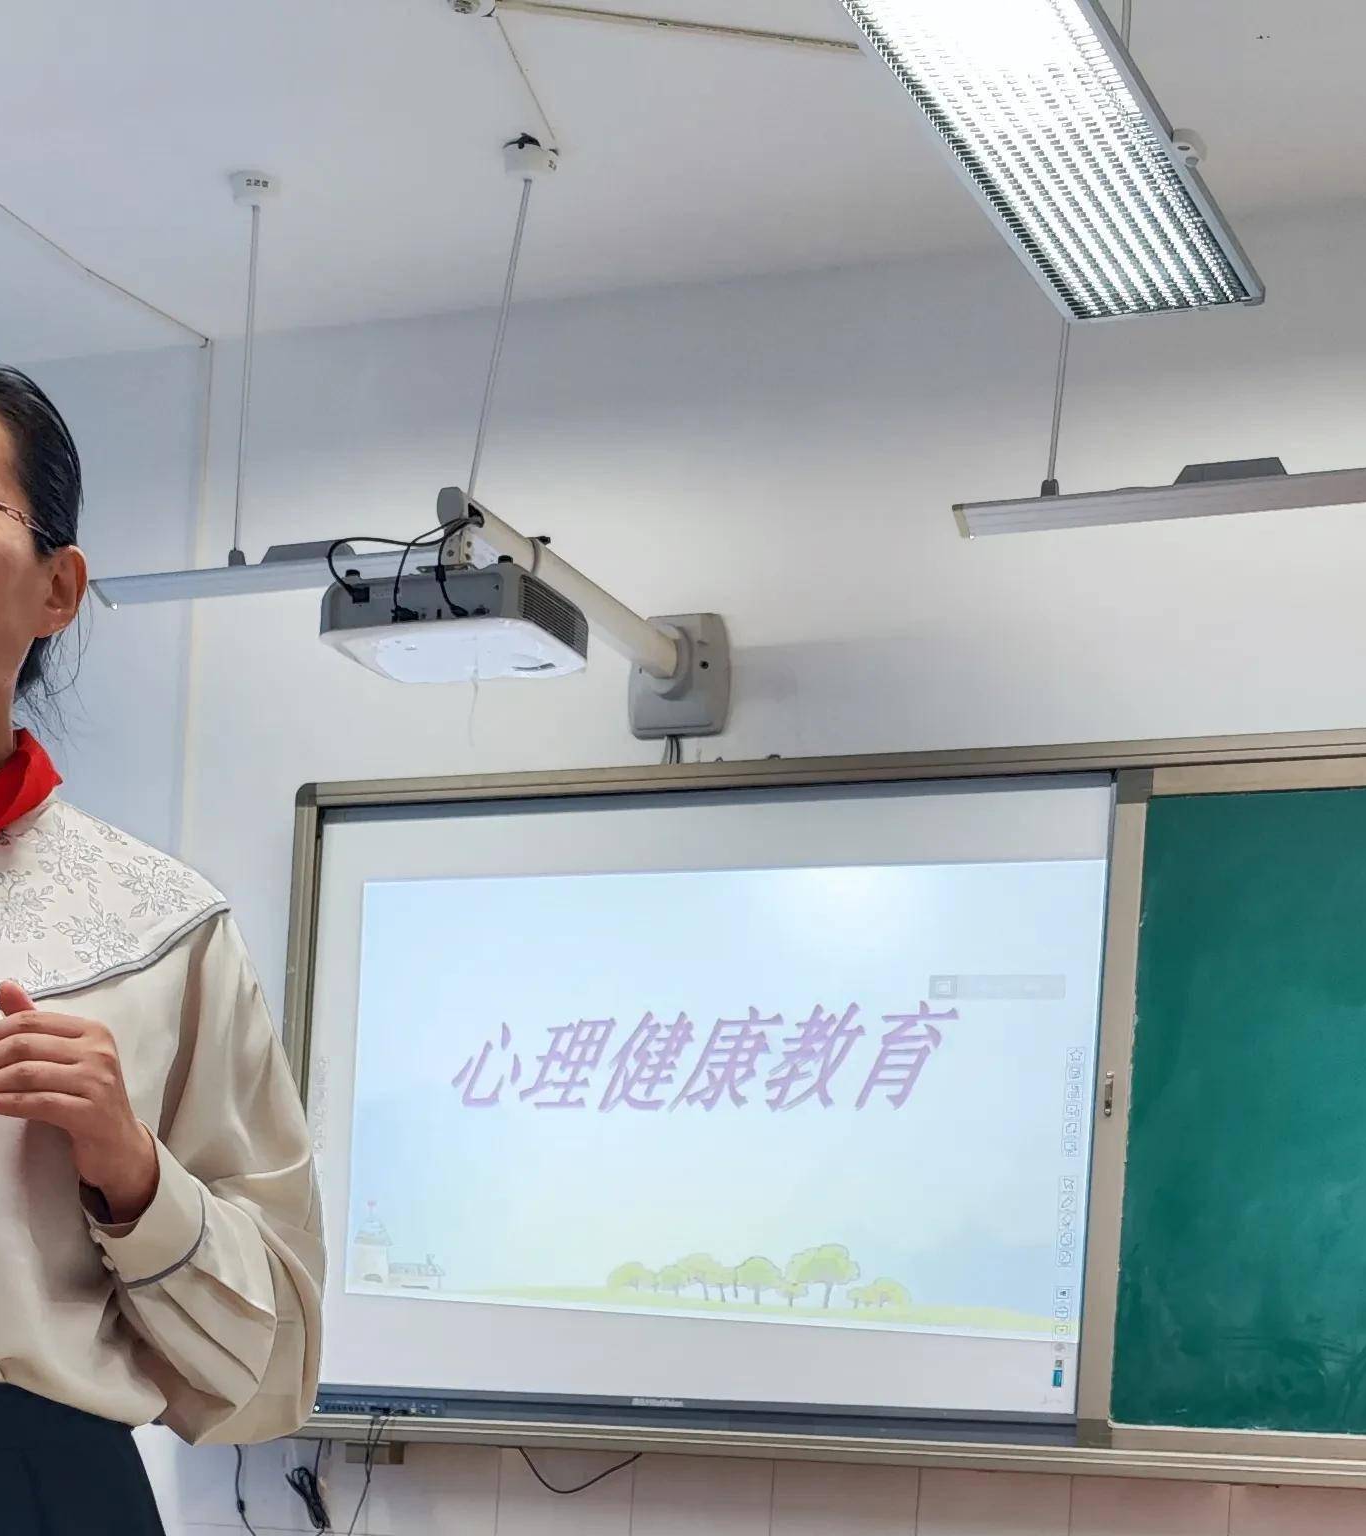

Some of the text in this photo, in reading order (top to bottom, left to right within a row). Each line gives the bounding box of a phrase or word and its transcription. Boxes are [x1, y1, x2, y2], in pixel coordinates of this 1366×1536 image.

[450, 1000, 961, 1114] 心理健康教育
